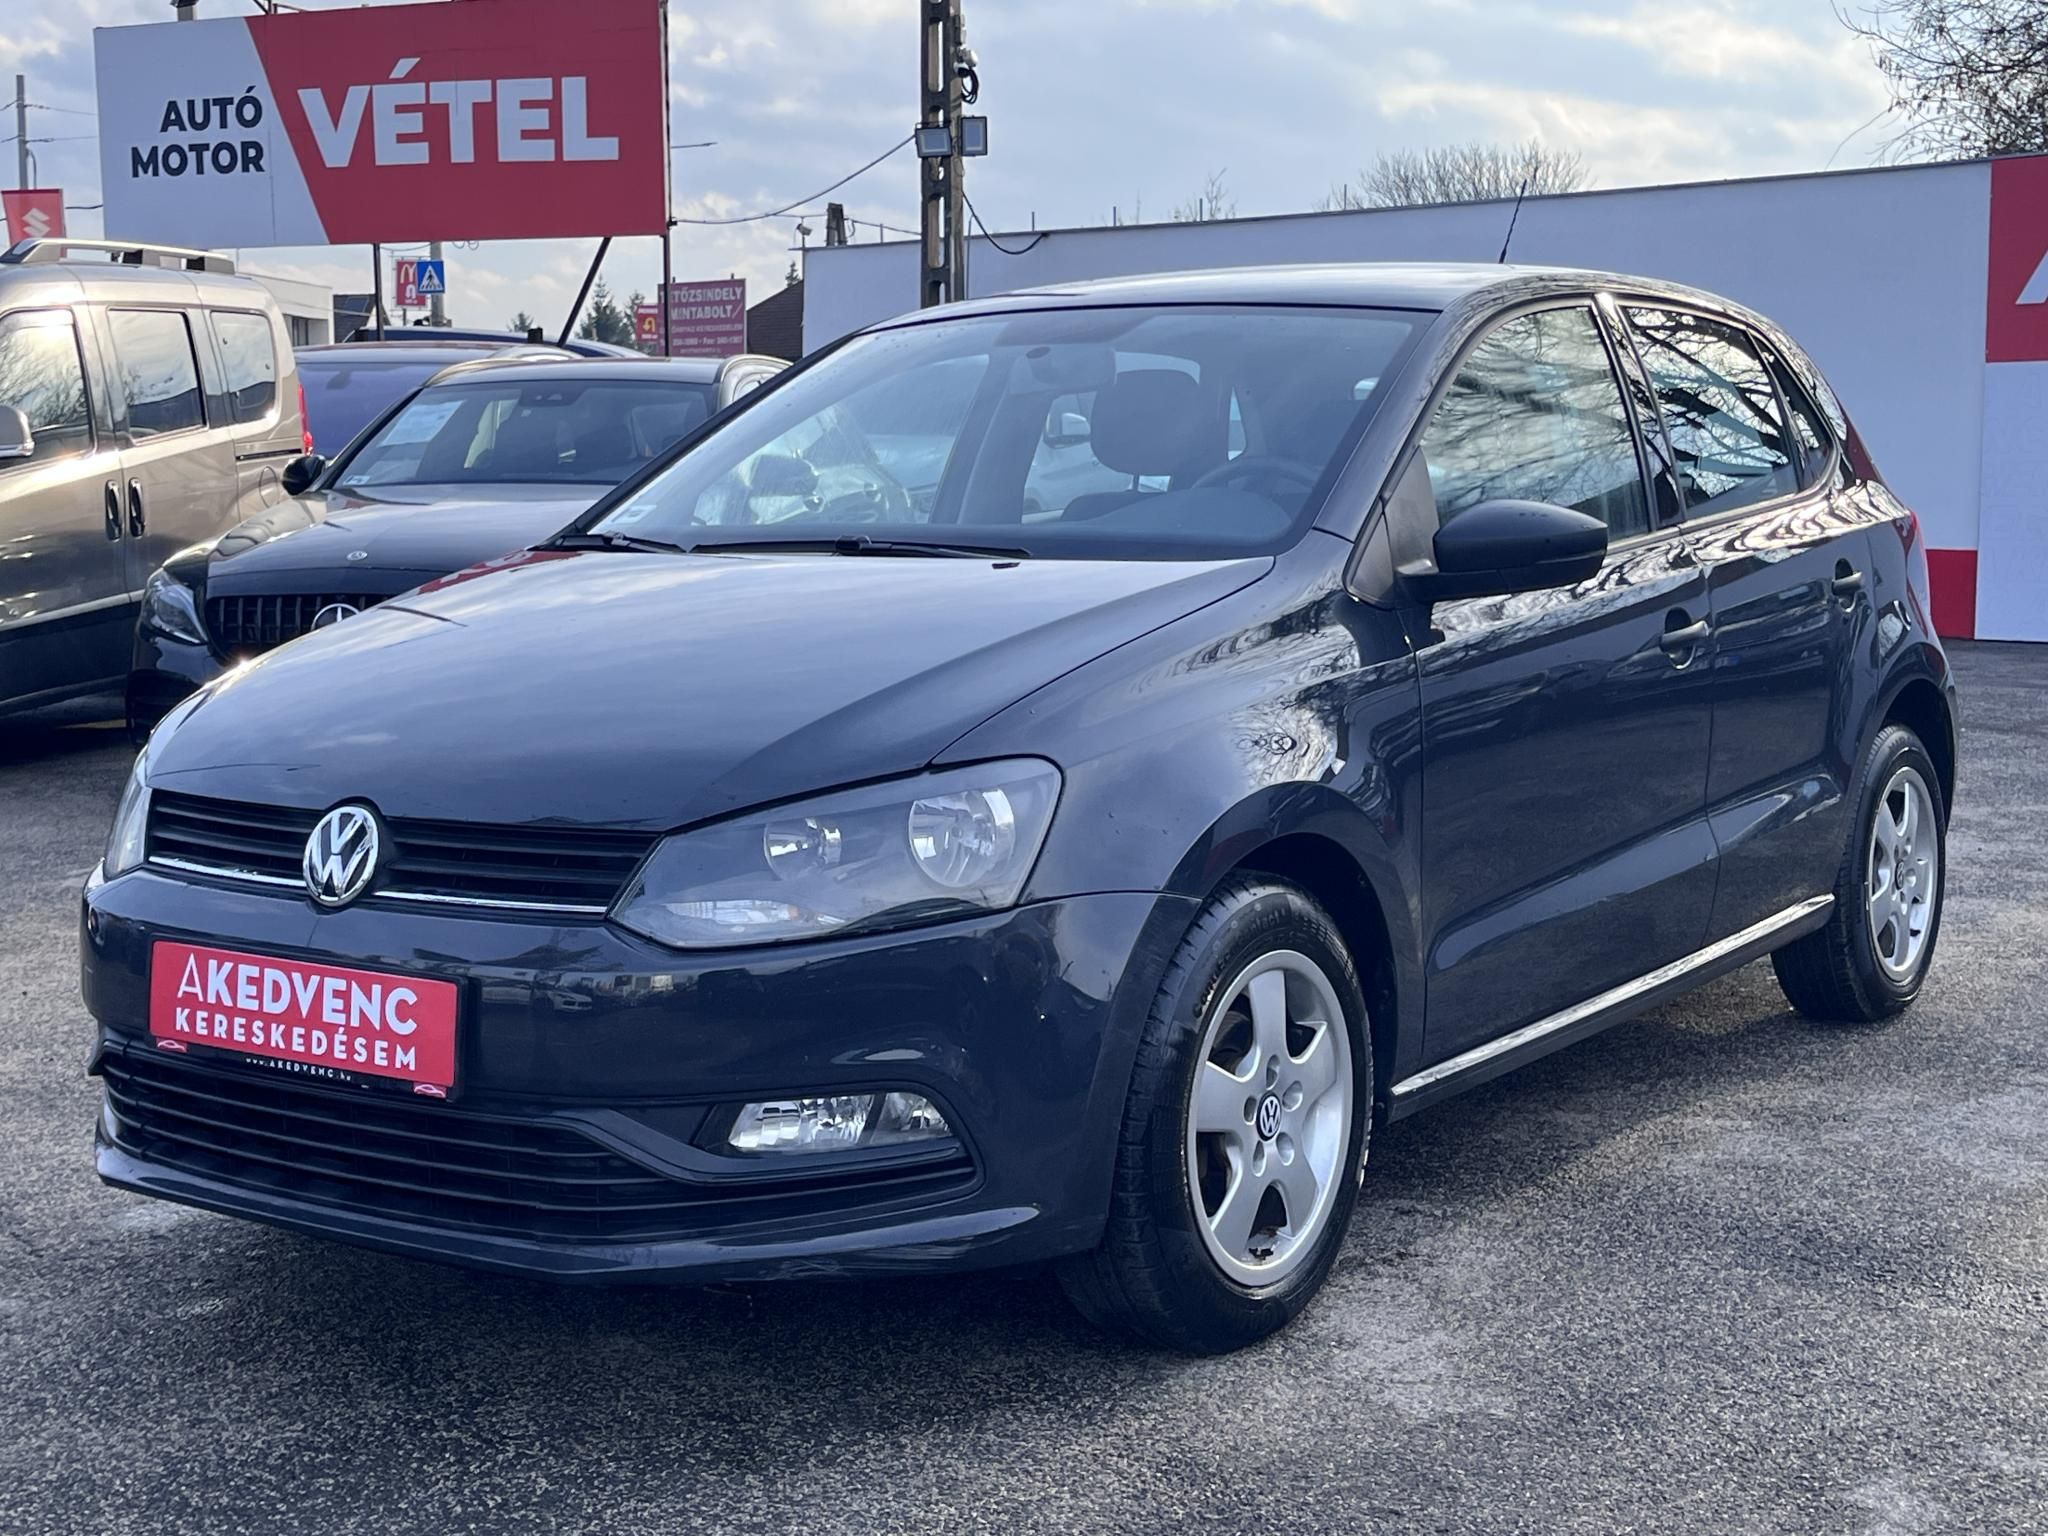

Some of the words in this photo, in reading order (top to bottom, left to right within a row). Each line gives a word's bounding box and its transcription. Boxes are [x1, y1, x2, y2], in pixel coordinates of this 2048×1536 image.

[160, 85, 264, 134] AUTÓ
[297, 57, 619, 169] VÉTEL
[131, 140, 265, 178] MOTOR
[175, 1006, 416, 1072] KERESKEDÉSEM
